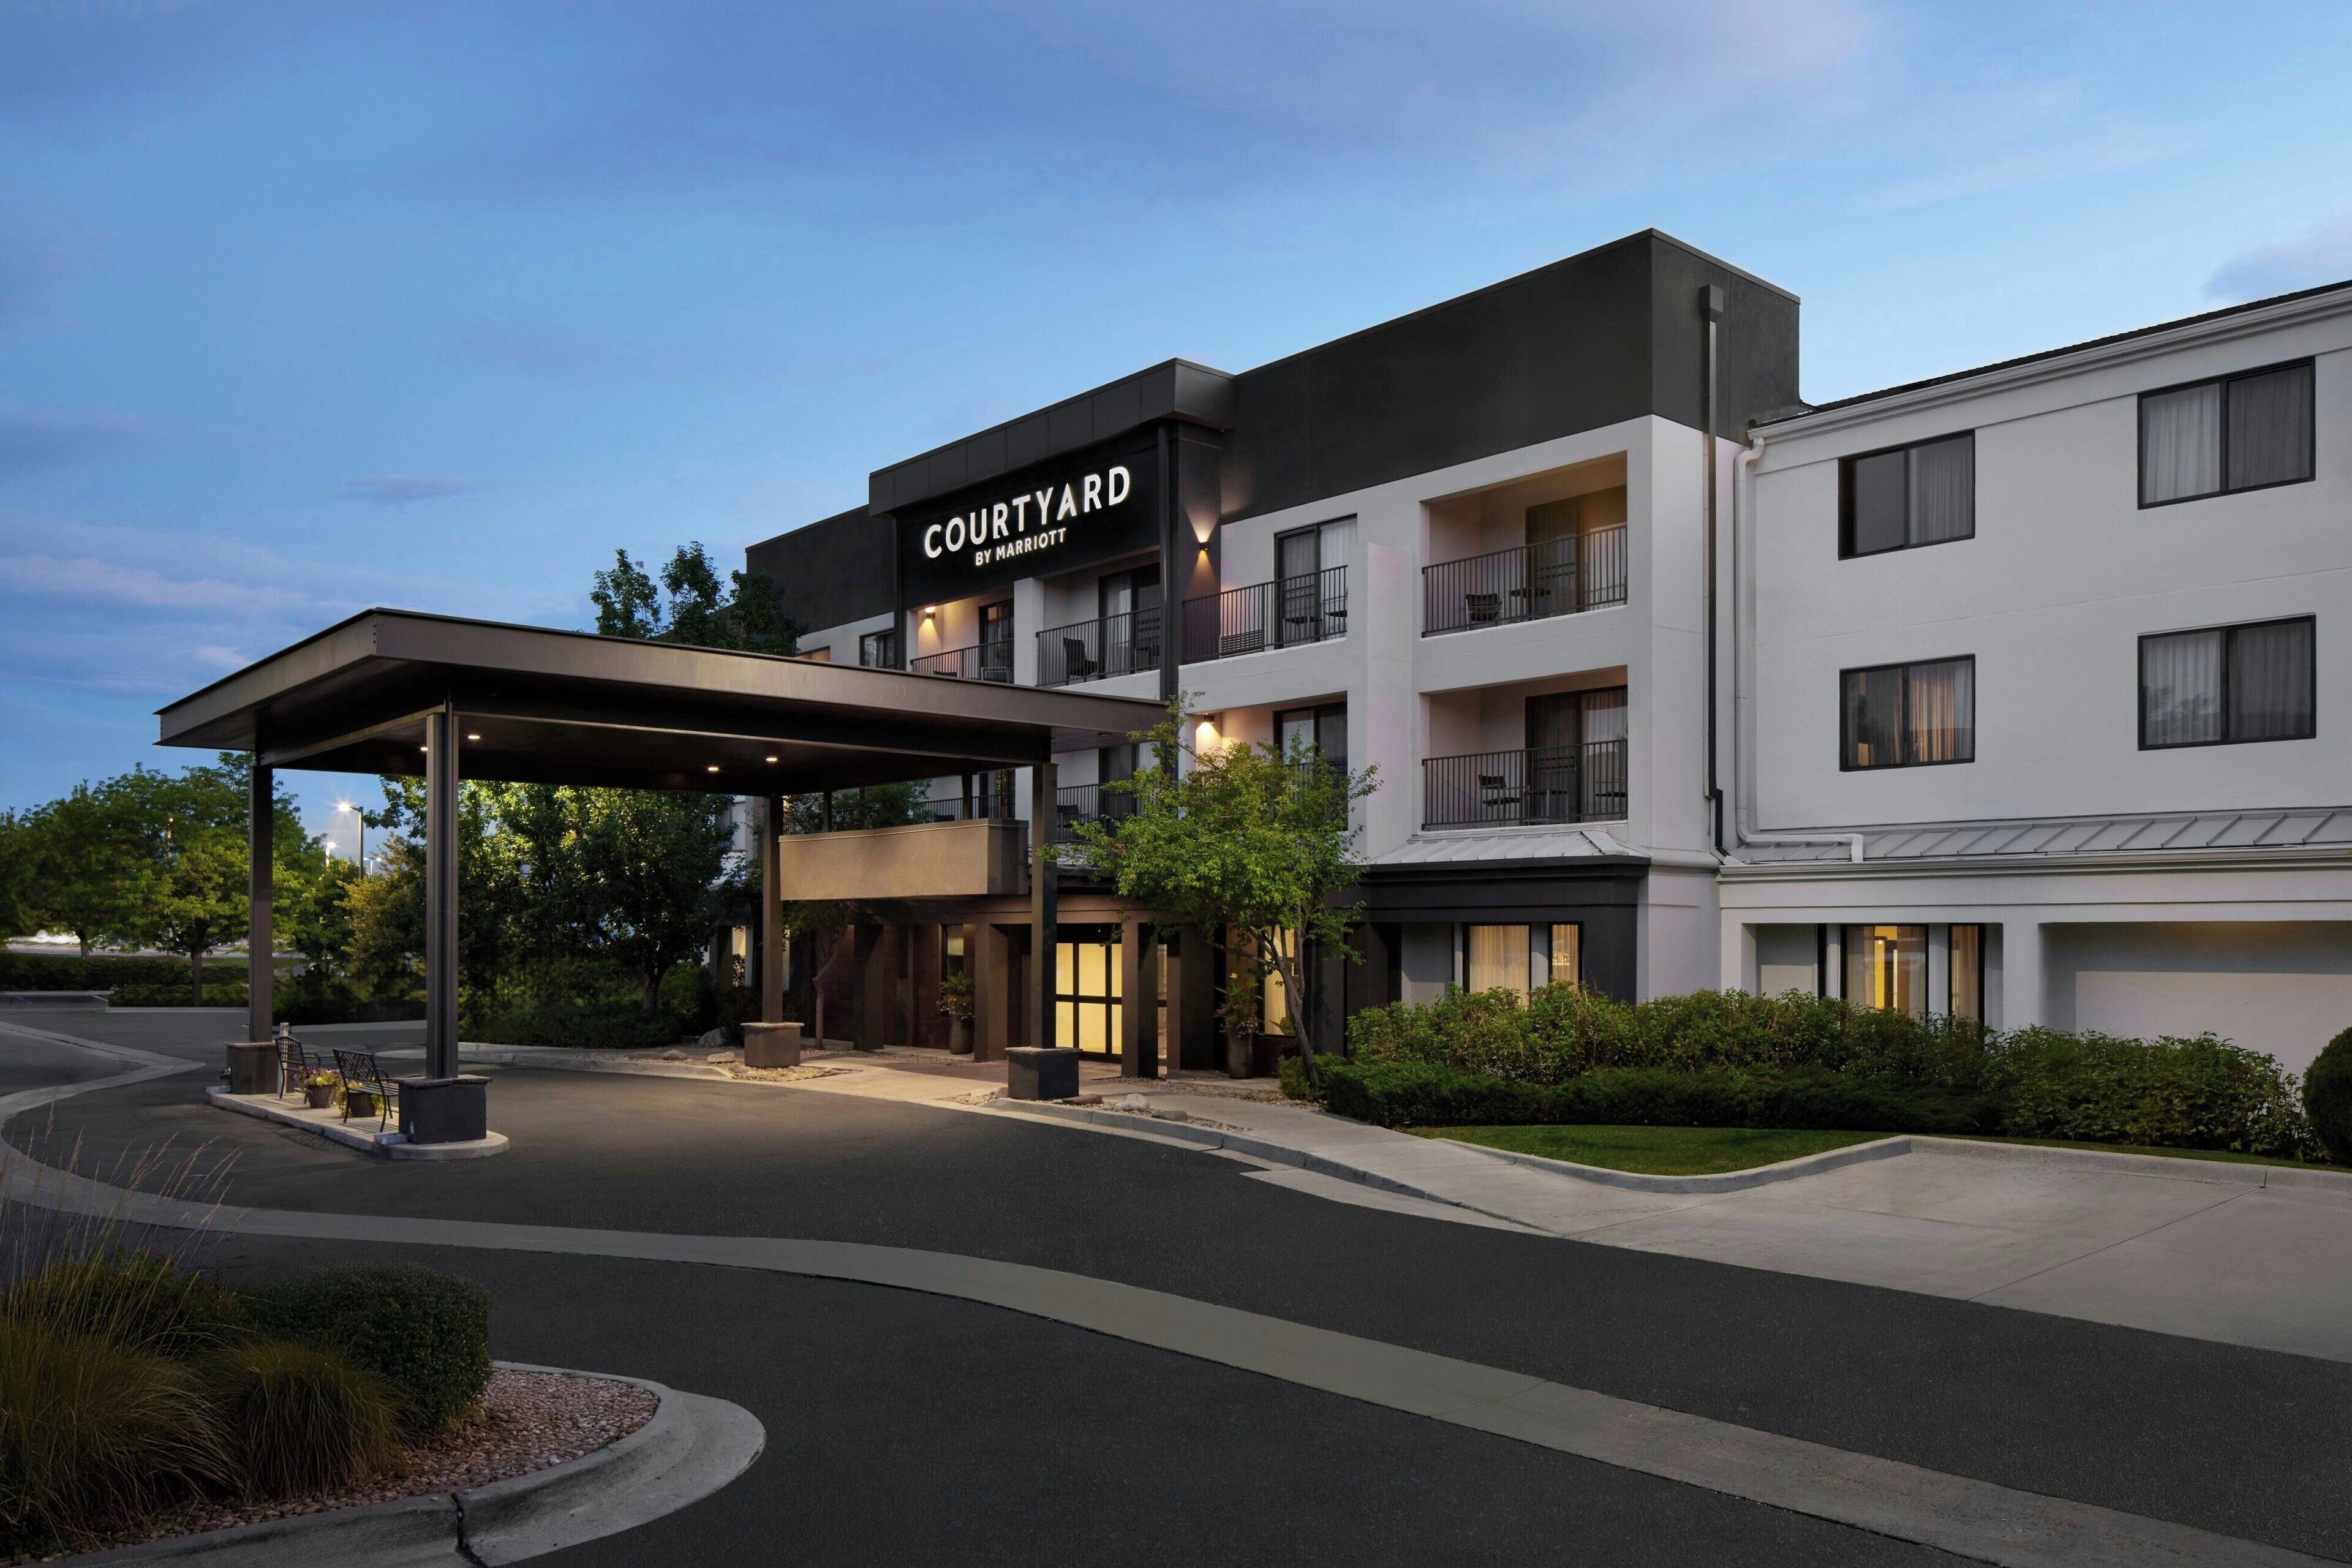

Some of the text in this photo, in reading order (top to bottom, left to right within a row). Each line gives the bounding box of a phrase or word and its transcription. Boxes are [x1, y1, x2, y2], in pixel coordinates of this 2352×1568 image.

[924, 466, 1130, 558] COURTYARD
[976, 528, 1066, 566] BY MARRIOTT
